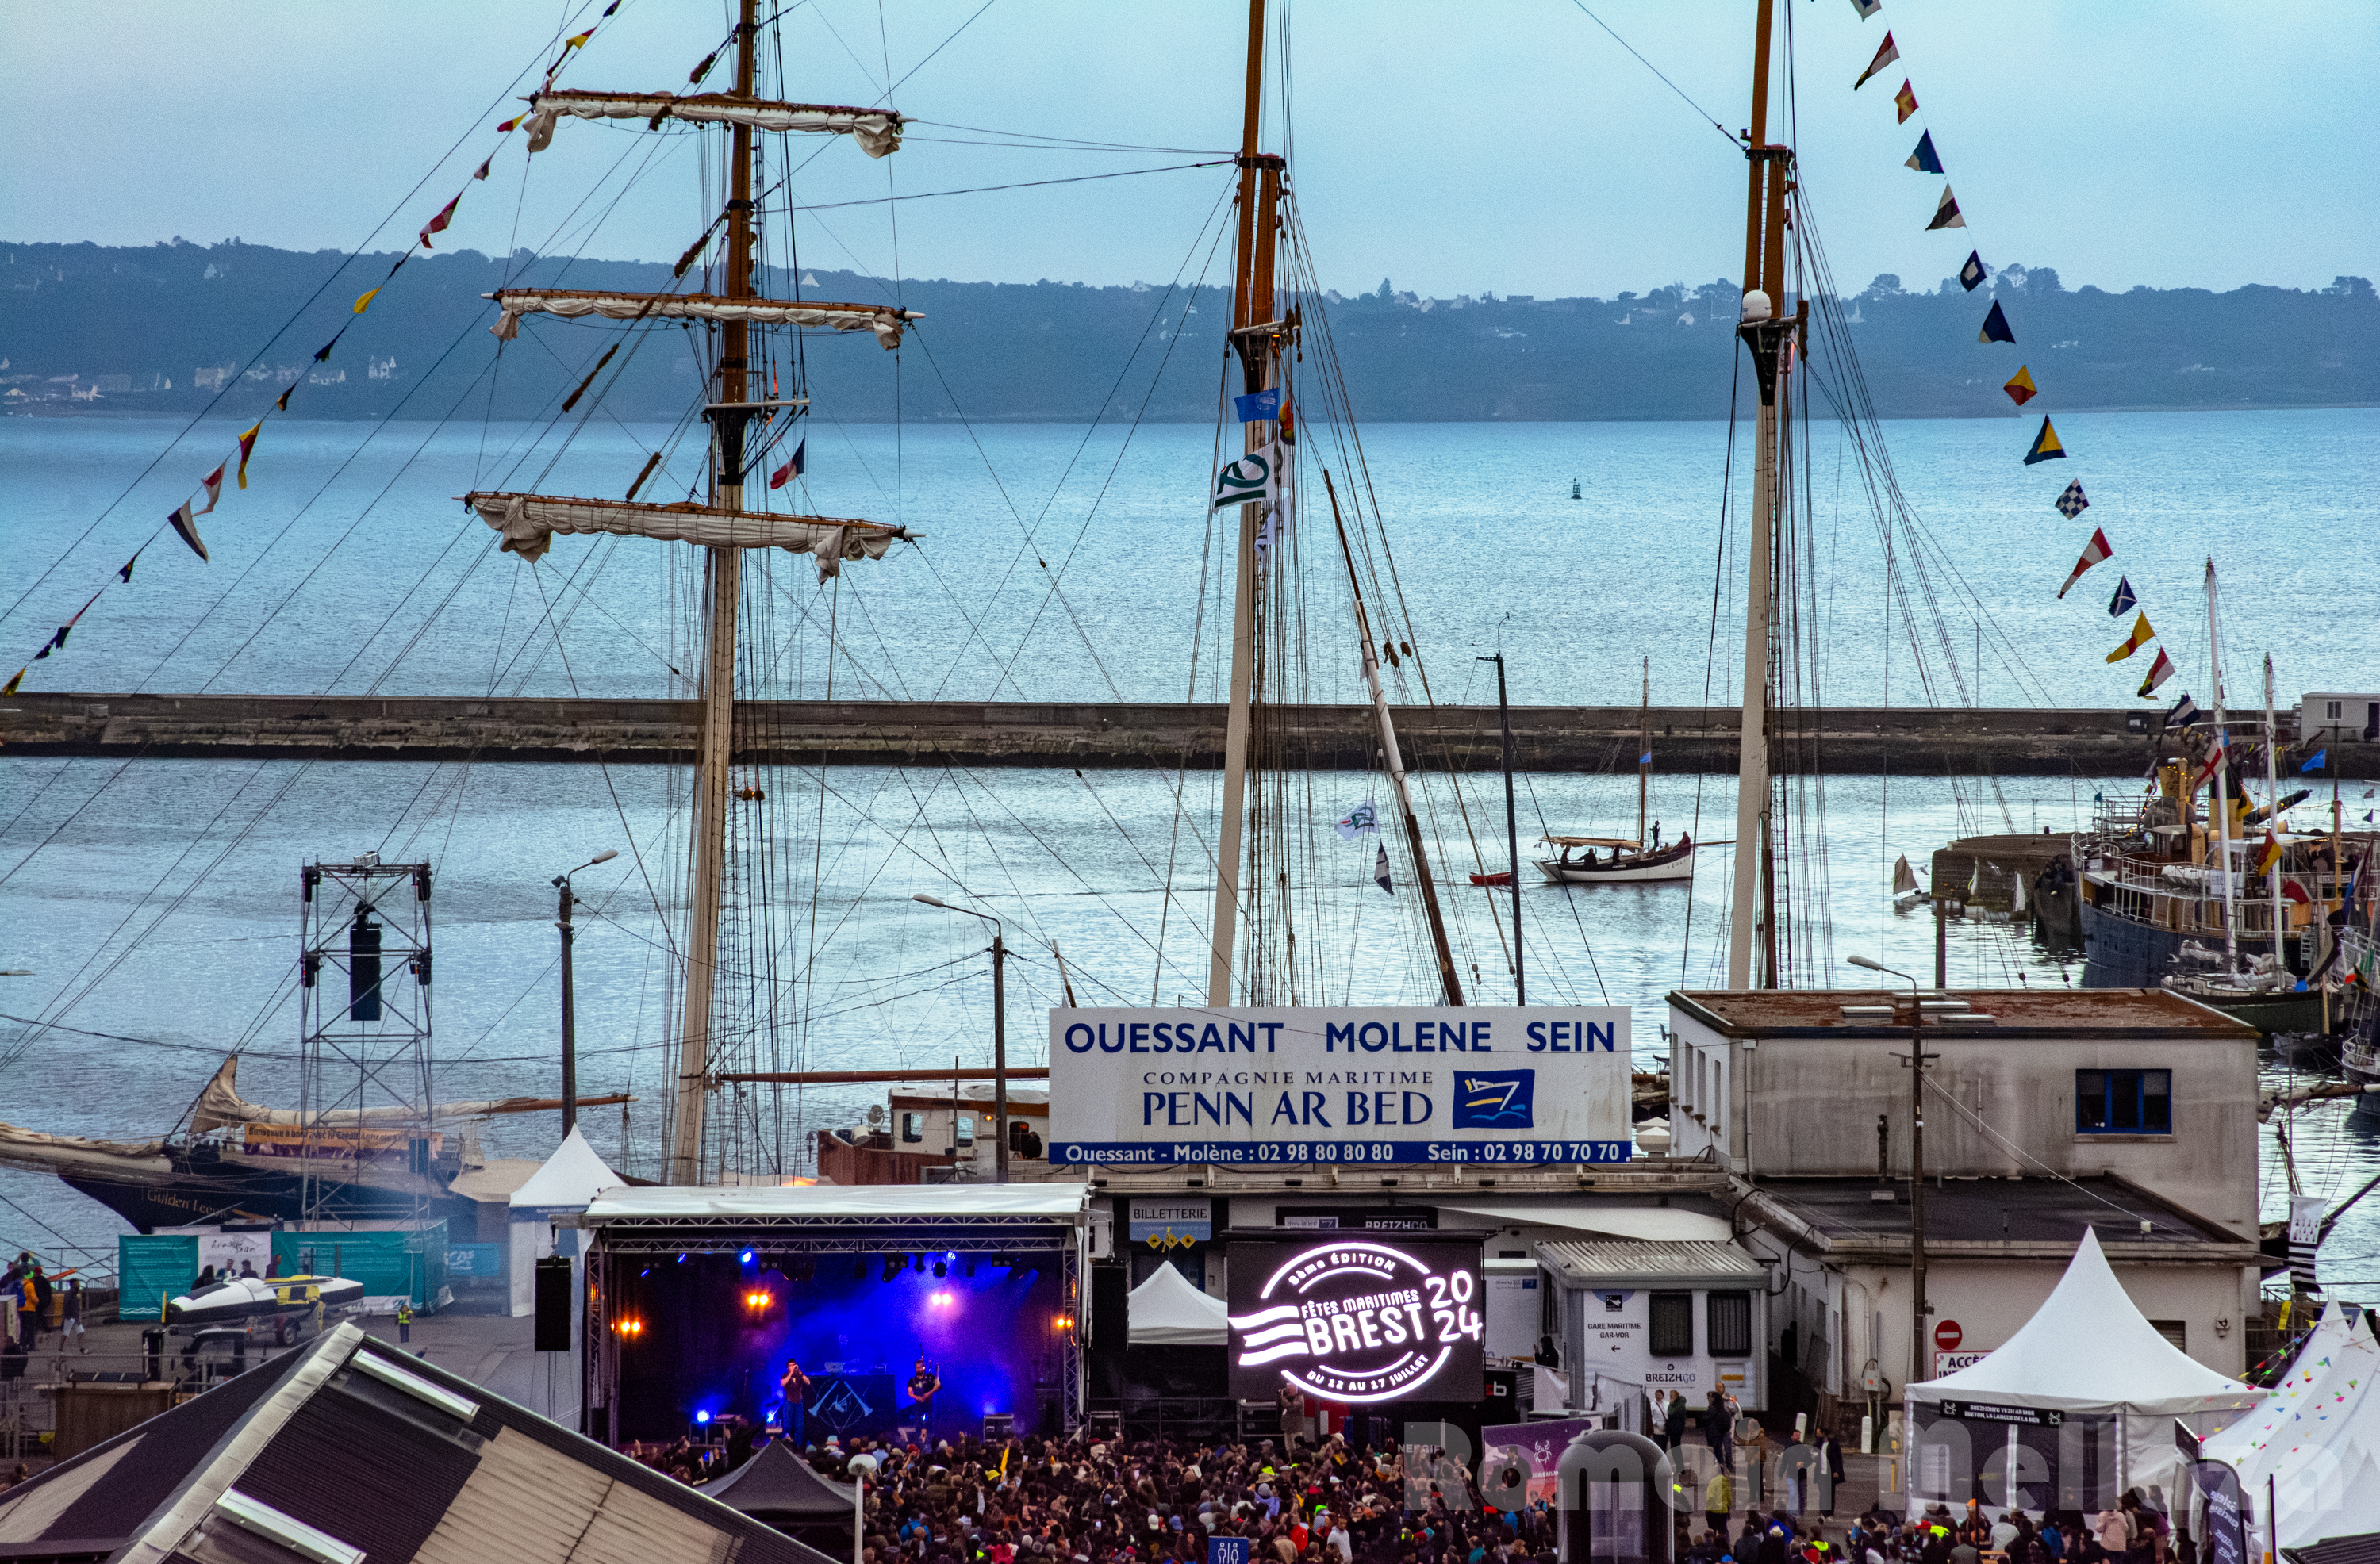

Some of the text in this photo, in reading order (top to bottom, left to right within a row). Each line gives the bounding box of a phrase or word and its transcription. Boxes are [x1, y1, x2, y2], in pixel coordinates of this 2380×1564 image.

[1065, 1021, 1614, 1053] OUESSANT MOLENE SEIN
[1143, 1071, 1434, 1086] COMPAGNIE MARITIME
[1143, 1091, 1433, 1128] PENN AR BED
[1065, 1144, 1156, 1162] Ouessant
[1173, 1144, 1243, 1161] Molène
[1258, 1144, 1280, 1161] 02
[1286, 1144, 1308, 1161] 98
[1315, 1144, 1338, 1161] 80
[1343, 1144, 1365, 1161] 80
[1371, 1144, 1394, 1161] 80
[1428, 1144, 1468, 1160] Sein
[1484, 1144, 1507, 1160] 02
[1512, 1144, 1534, 1160] 98
[1541, 1144, 1563, 1160] 70
[1569, 1144, 1591, 1160] 70
[1598, 1144, 1620, 1160] 70
[1133, 1208, 1207, 1220] BILLETTERIE
[1330, 1252, 1396, 1271] ÉDITION
[1425, 1269, 1473, 1309] 20
[1301, 1289, 1420, 1319] FÊTES MARITIMES
[1305, 1302, 1425, 1355] BREST
[1433, 1305, 1484, 1342] 24
[1306, 1353, 1429, 1391] DU 12 AU 17 JUILLET
[1948, 1354, 1986, 1368] ACCÈ
[1645, 1373, 1696, 1383] BREIZHGO
